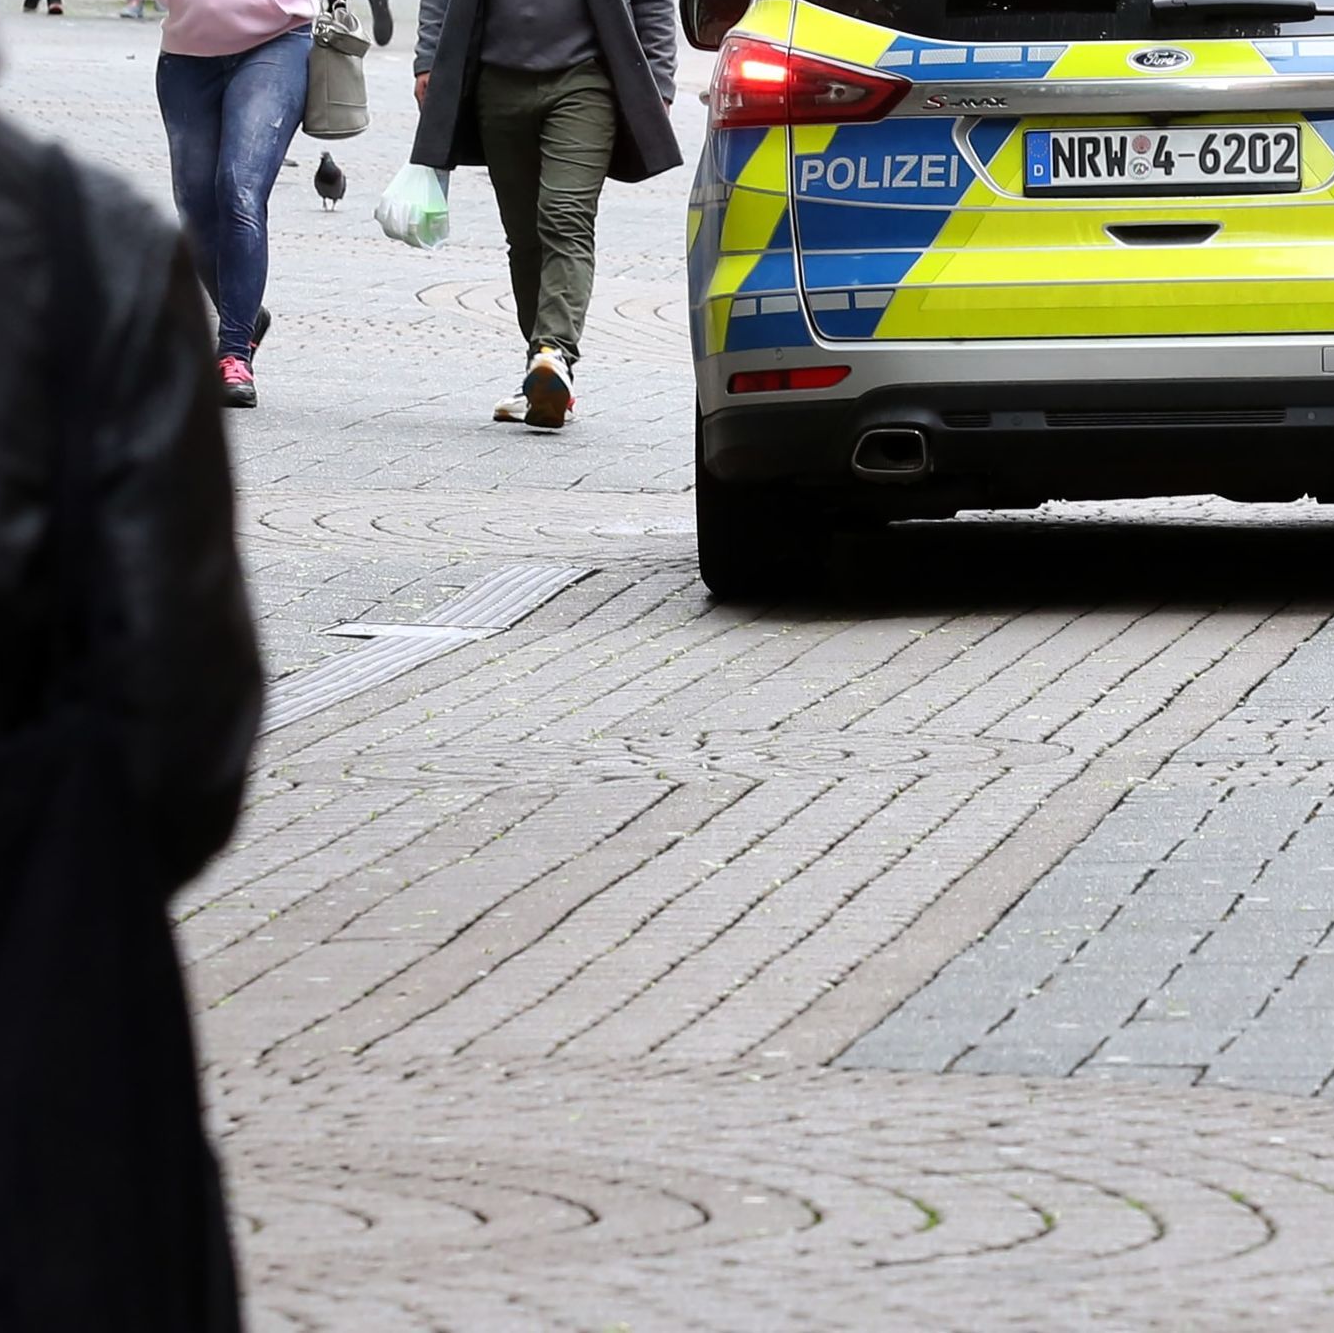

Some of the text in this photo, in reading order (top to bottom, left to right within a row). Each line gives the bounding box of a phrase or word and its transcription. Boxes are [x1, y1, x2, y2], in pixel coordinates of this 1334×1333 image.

[800, 154, 959, 193] POLIZEI
[1052, 135, 1127, 178] NRW
[1152, 132, 1297, 177] 4-6202
